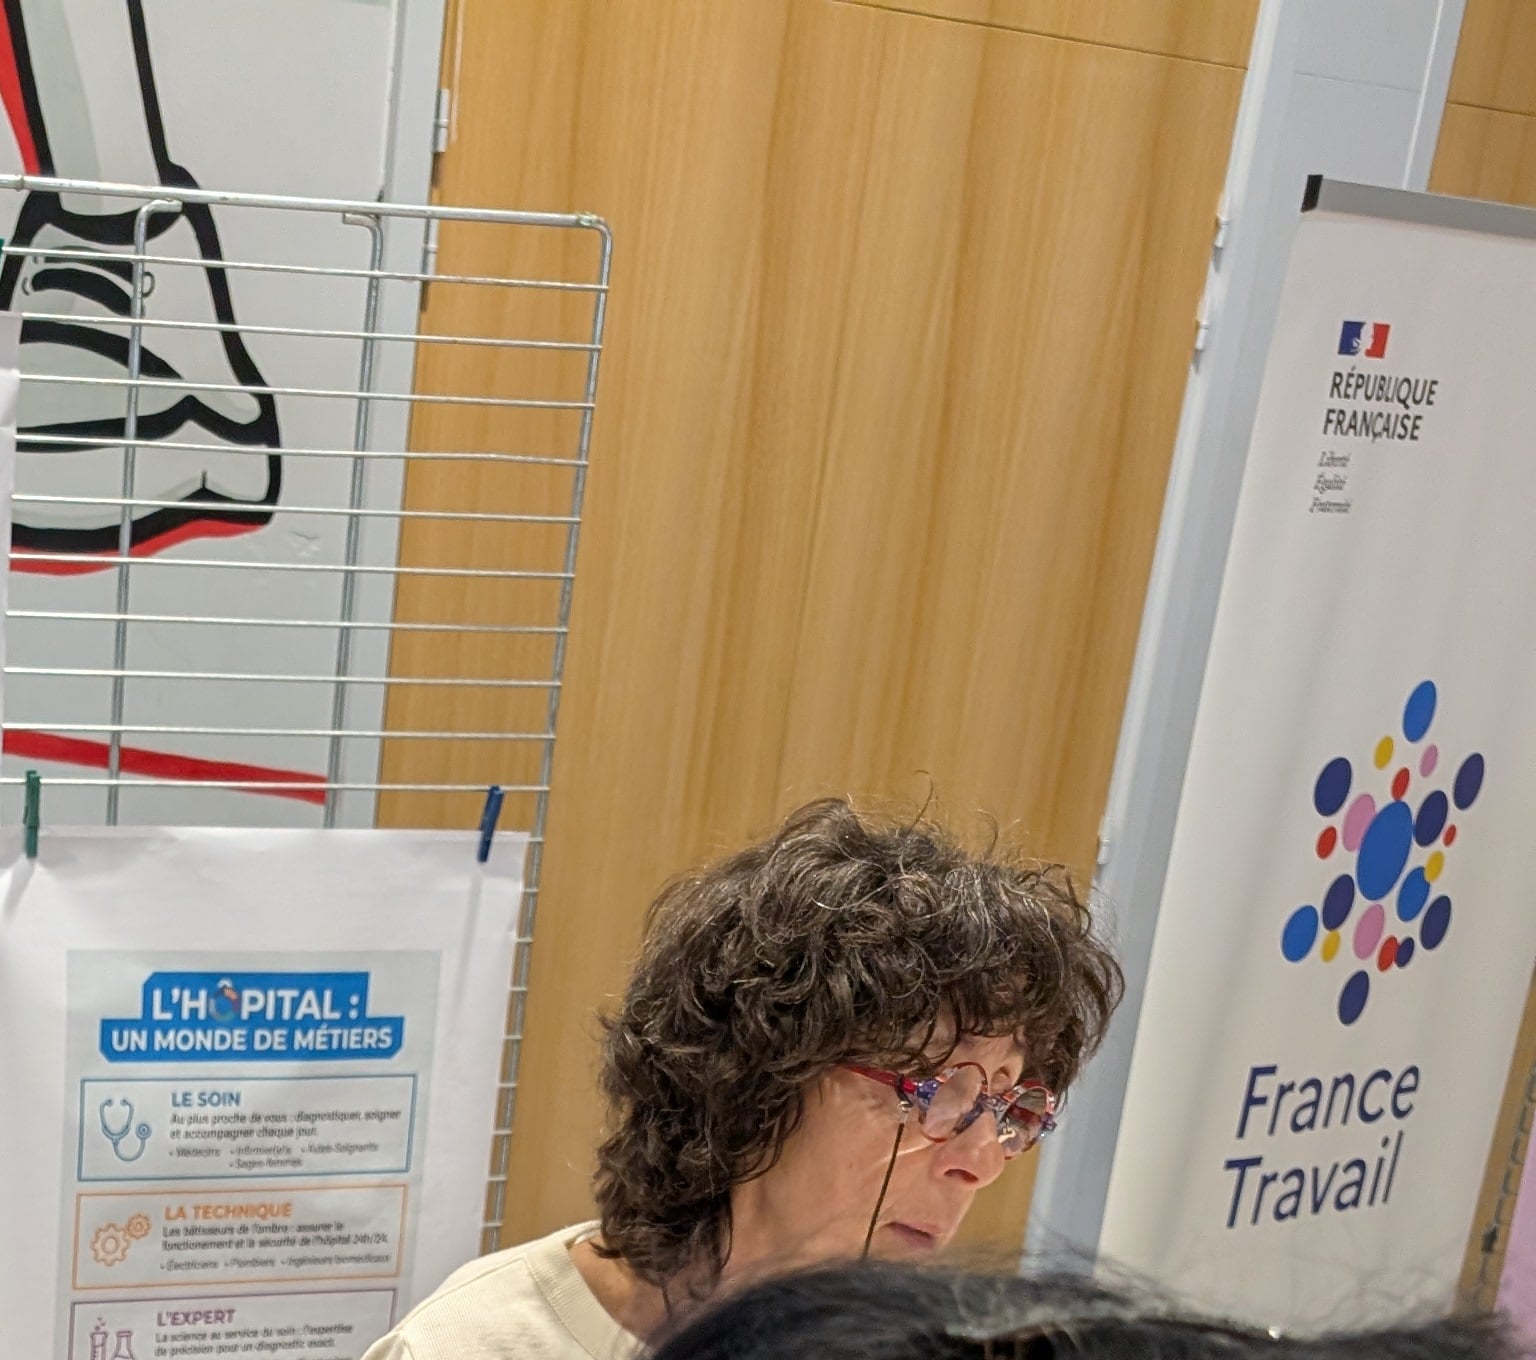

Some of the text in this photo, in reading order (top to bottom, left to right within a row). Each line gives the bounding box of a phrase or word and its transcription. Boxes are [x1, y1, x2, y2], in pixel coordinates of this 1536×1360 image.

[1329, 365, 1439, 410] RÉPUBLIQUE
[1323, 408, 1423, 443] FRANÇAISE
[112, 1024, 392, 1052] UN MONDE DE MÉTIERS
[171, 1091, 241, 1107] LE SOIN
[1236, 1064, 1420, 1139] France
[1224, 1130, 1403, 1228] Travail
[165, 1202, 293, 1221] LA TECHNIQUE
[156, 1309, 236, 1328] L'EXPERT
